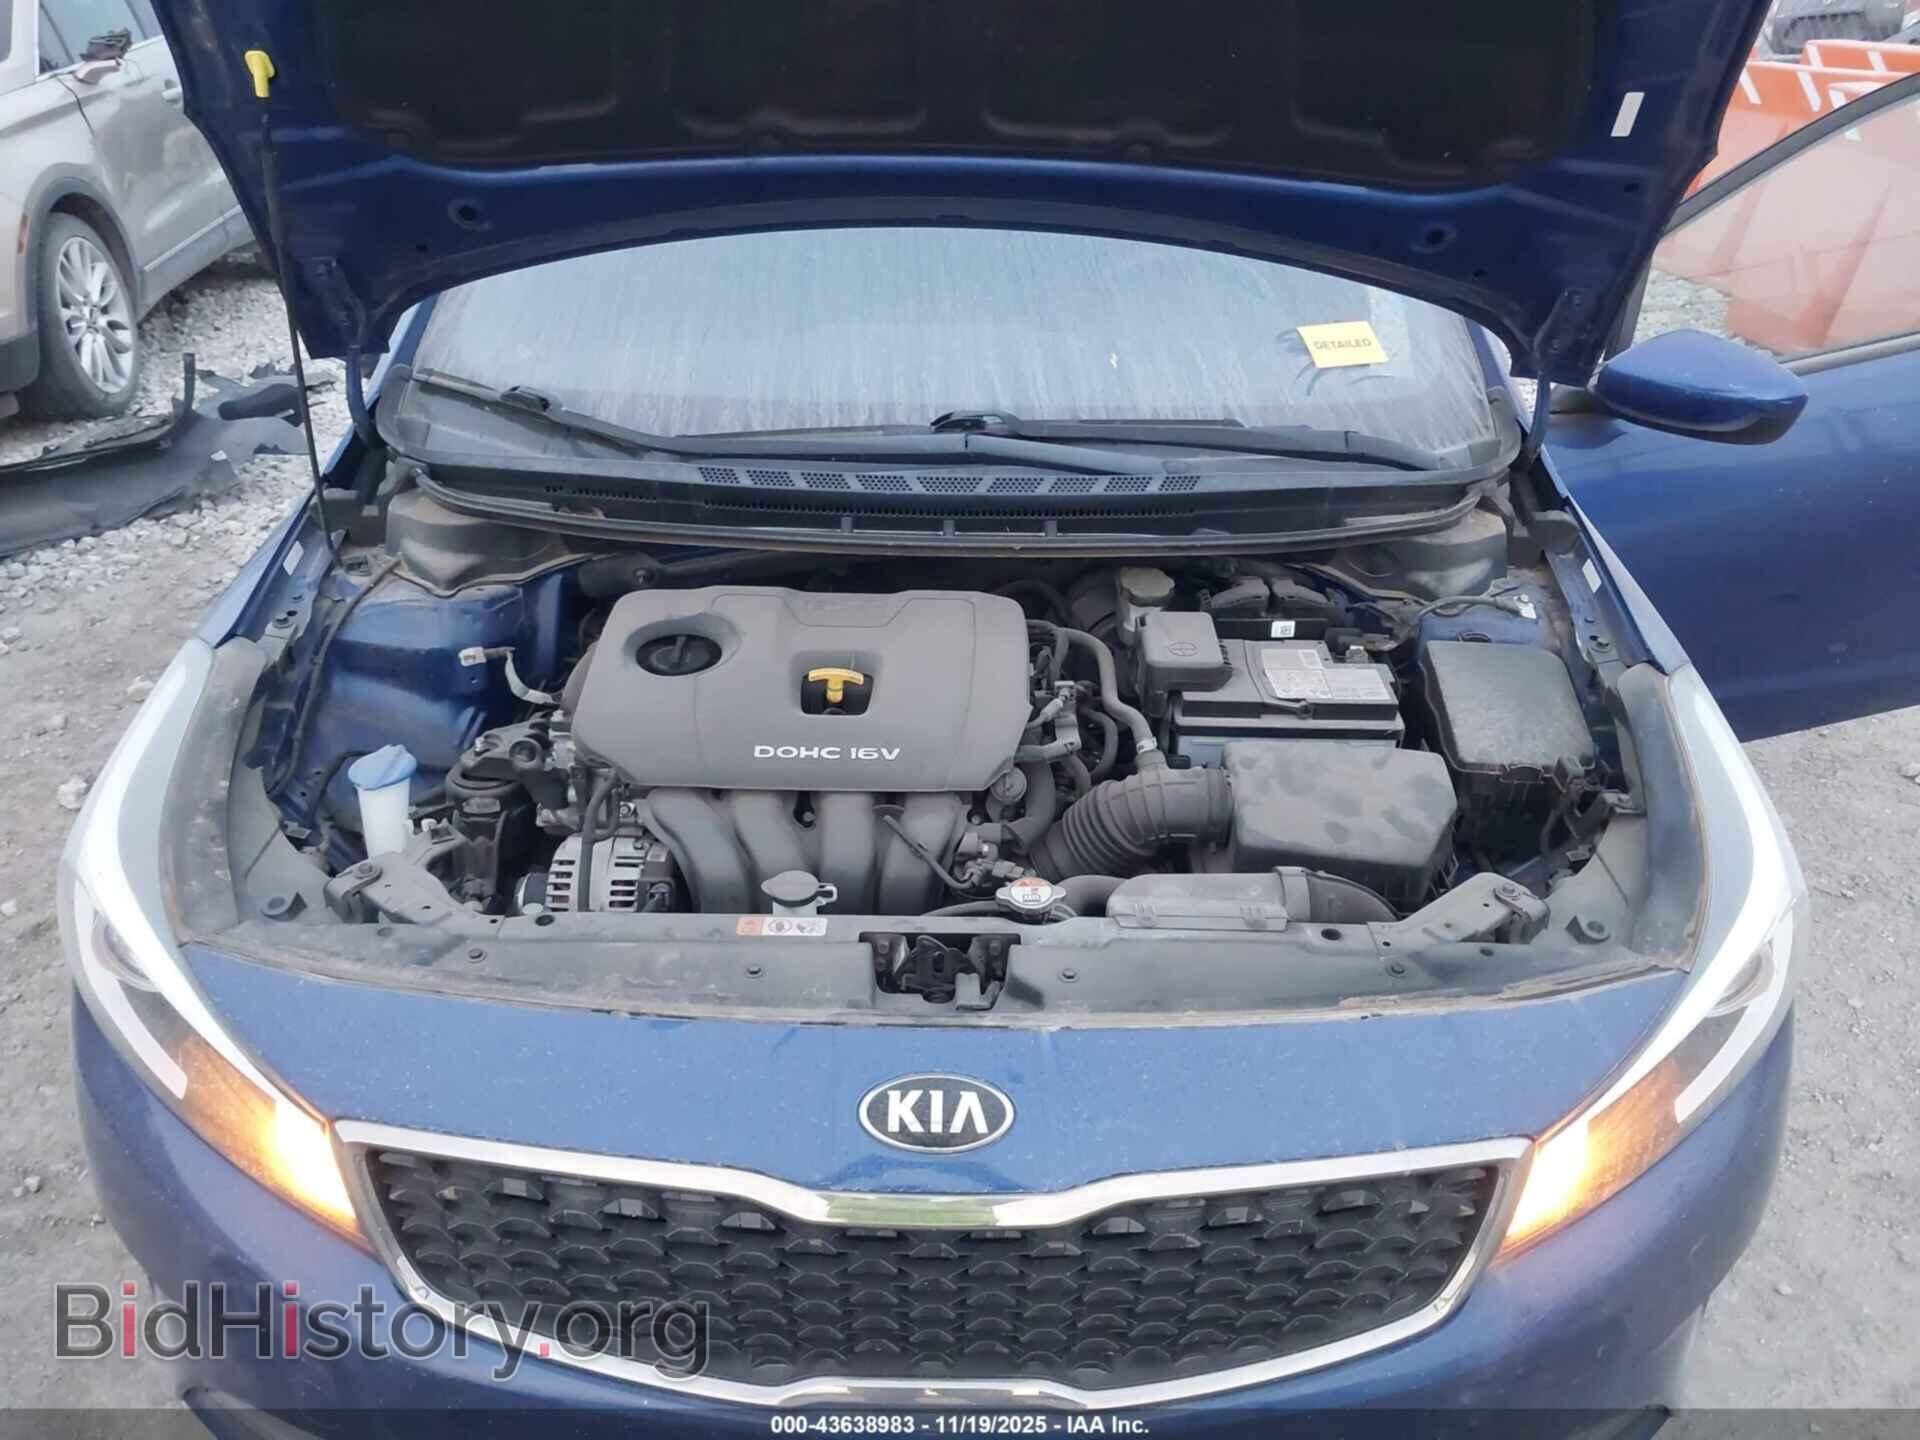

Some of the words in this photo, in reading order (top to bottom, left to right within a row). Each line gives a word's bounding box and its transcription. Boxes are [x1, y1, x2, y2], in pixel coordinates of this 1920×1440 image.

[1313, 338, 1372, 350] DETAILED
[753, 745, 841, 759] DOHC
[850, 747, 901, 760] 16V
[887, 1089, 989, 1134] KIA
